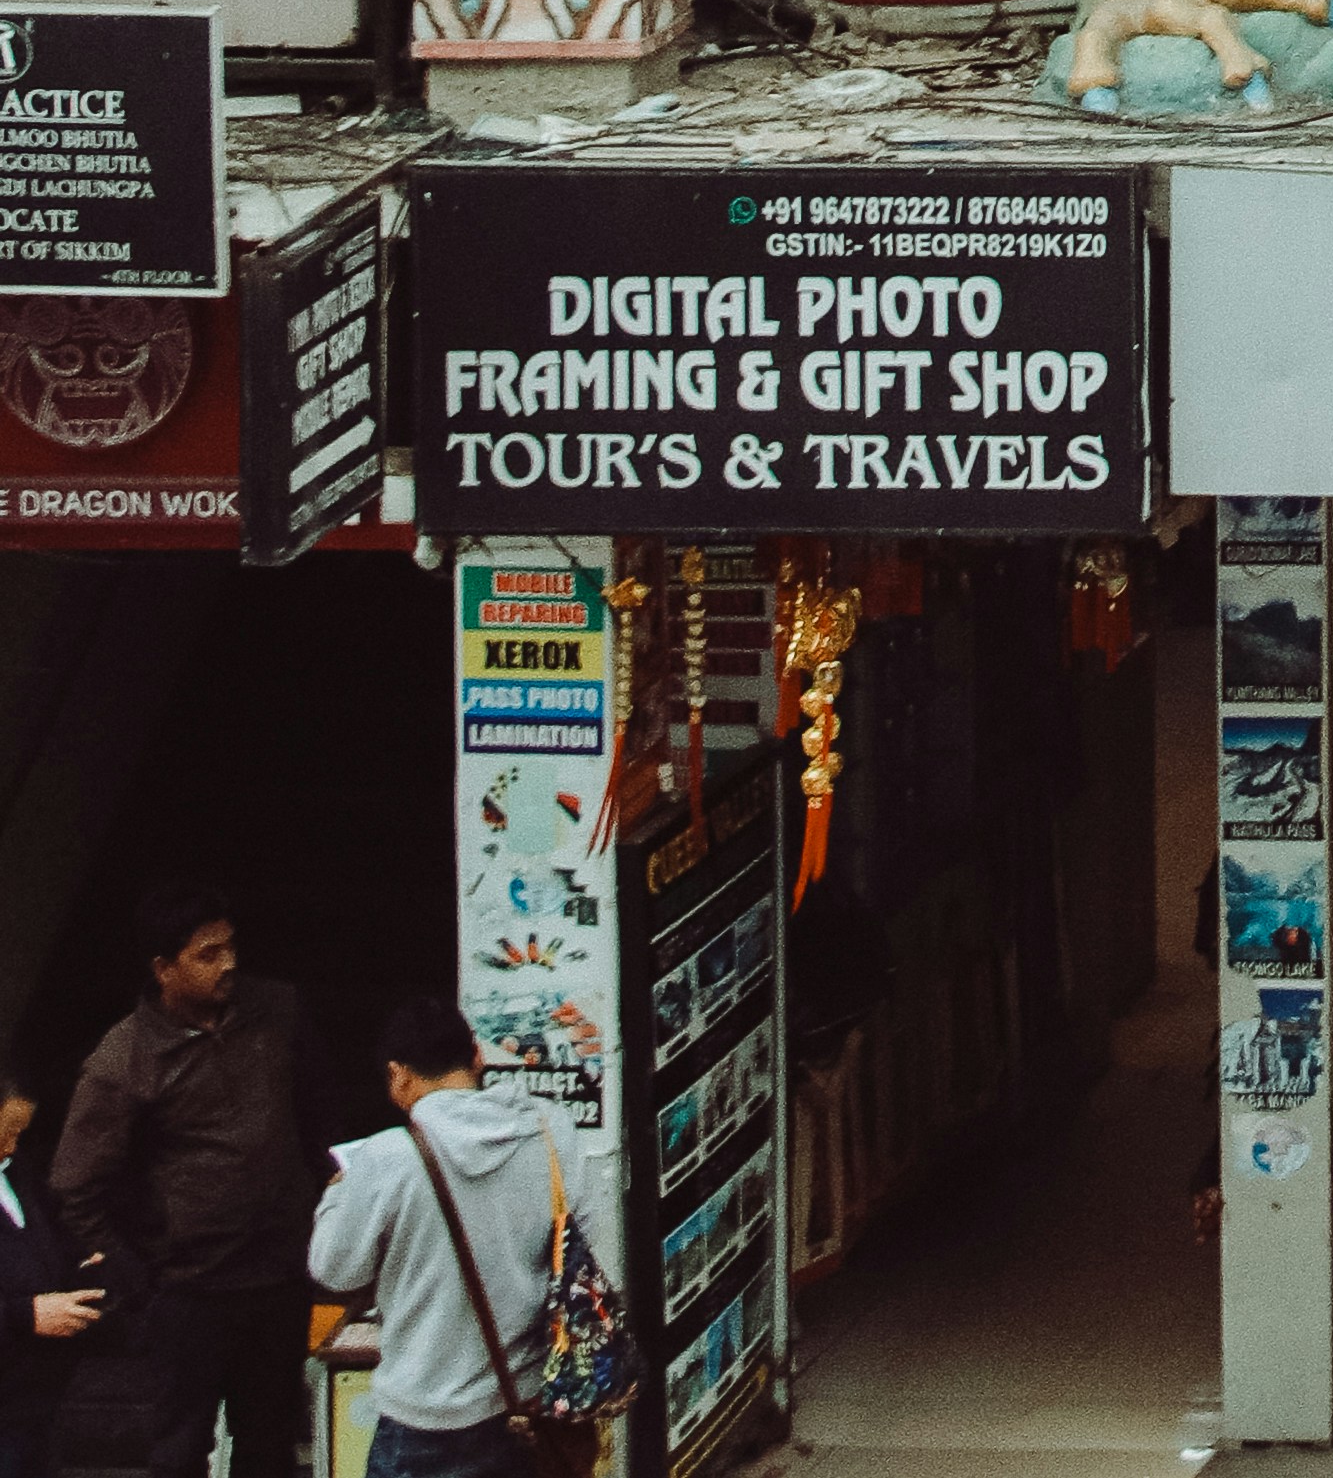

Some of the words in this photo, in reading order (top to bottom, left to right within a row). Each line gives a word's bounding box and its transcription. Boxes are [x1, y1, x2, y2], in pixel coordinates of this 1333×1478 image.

[761, 197, 802, 225] +91
[809, 196, 950, 225] 9647873222
[967, 196, 1109, 225] 8768454009
[547, 275, 779, 346] DIGITAL
[798, 275, 1003, 345] PHOTO
[444, 350, 718, 425] FRAMING
[736, 351, 781, 413] &
[801, 350, 939, 419] GIFT
[949, 350, 1109, 423] SHOP
[445, 434, 703, 490] TOUR'S
[724, 434, 784, 490] &
[803, 434, 1110, 491] TRAVELS
[19, 489, 152, 517] DRAGON
[160, 490, 242, 517] WOK
[495, 572, 572, 595] MOBILE
[485, 639, 583, 671] XEROX
[526, 687, 601, 712] PHOTO
[469, 723, 600, 751] LAMINATION
